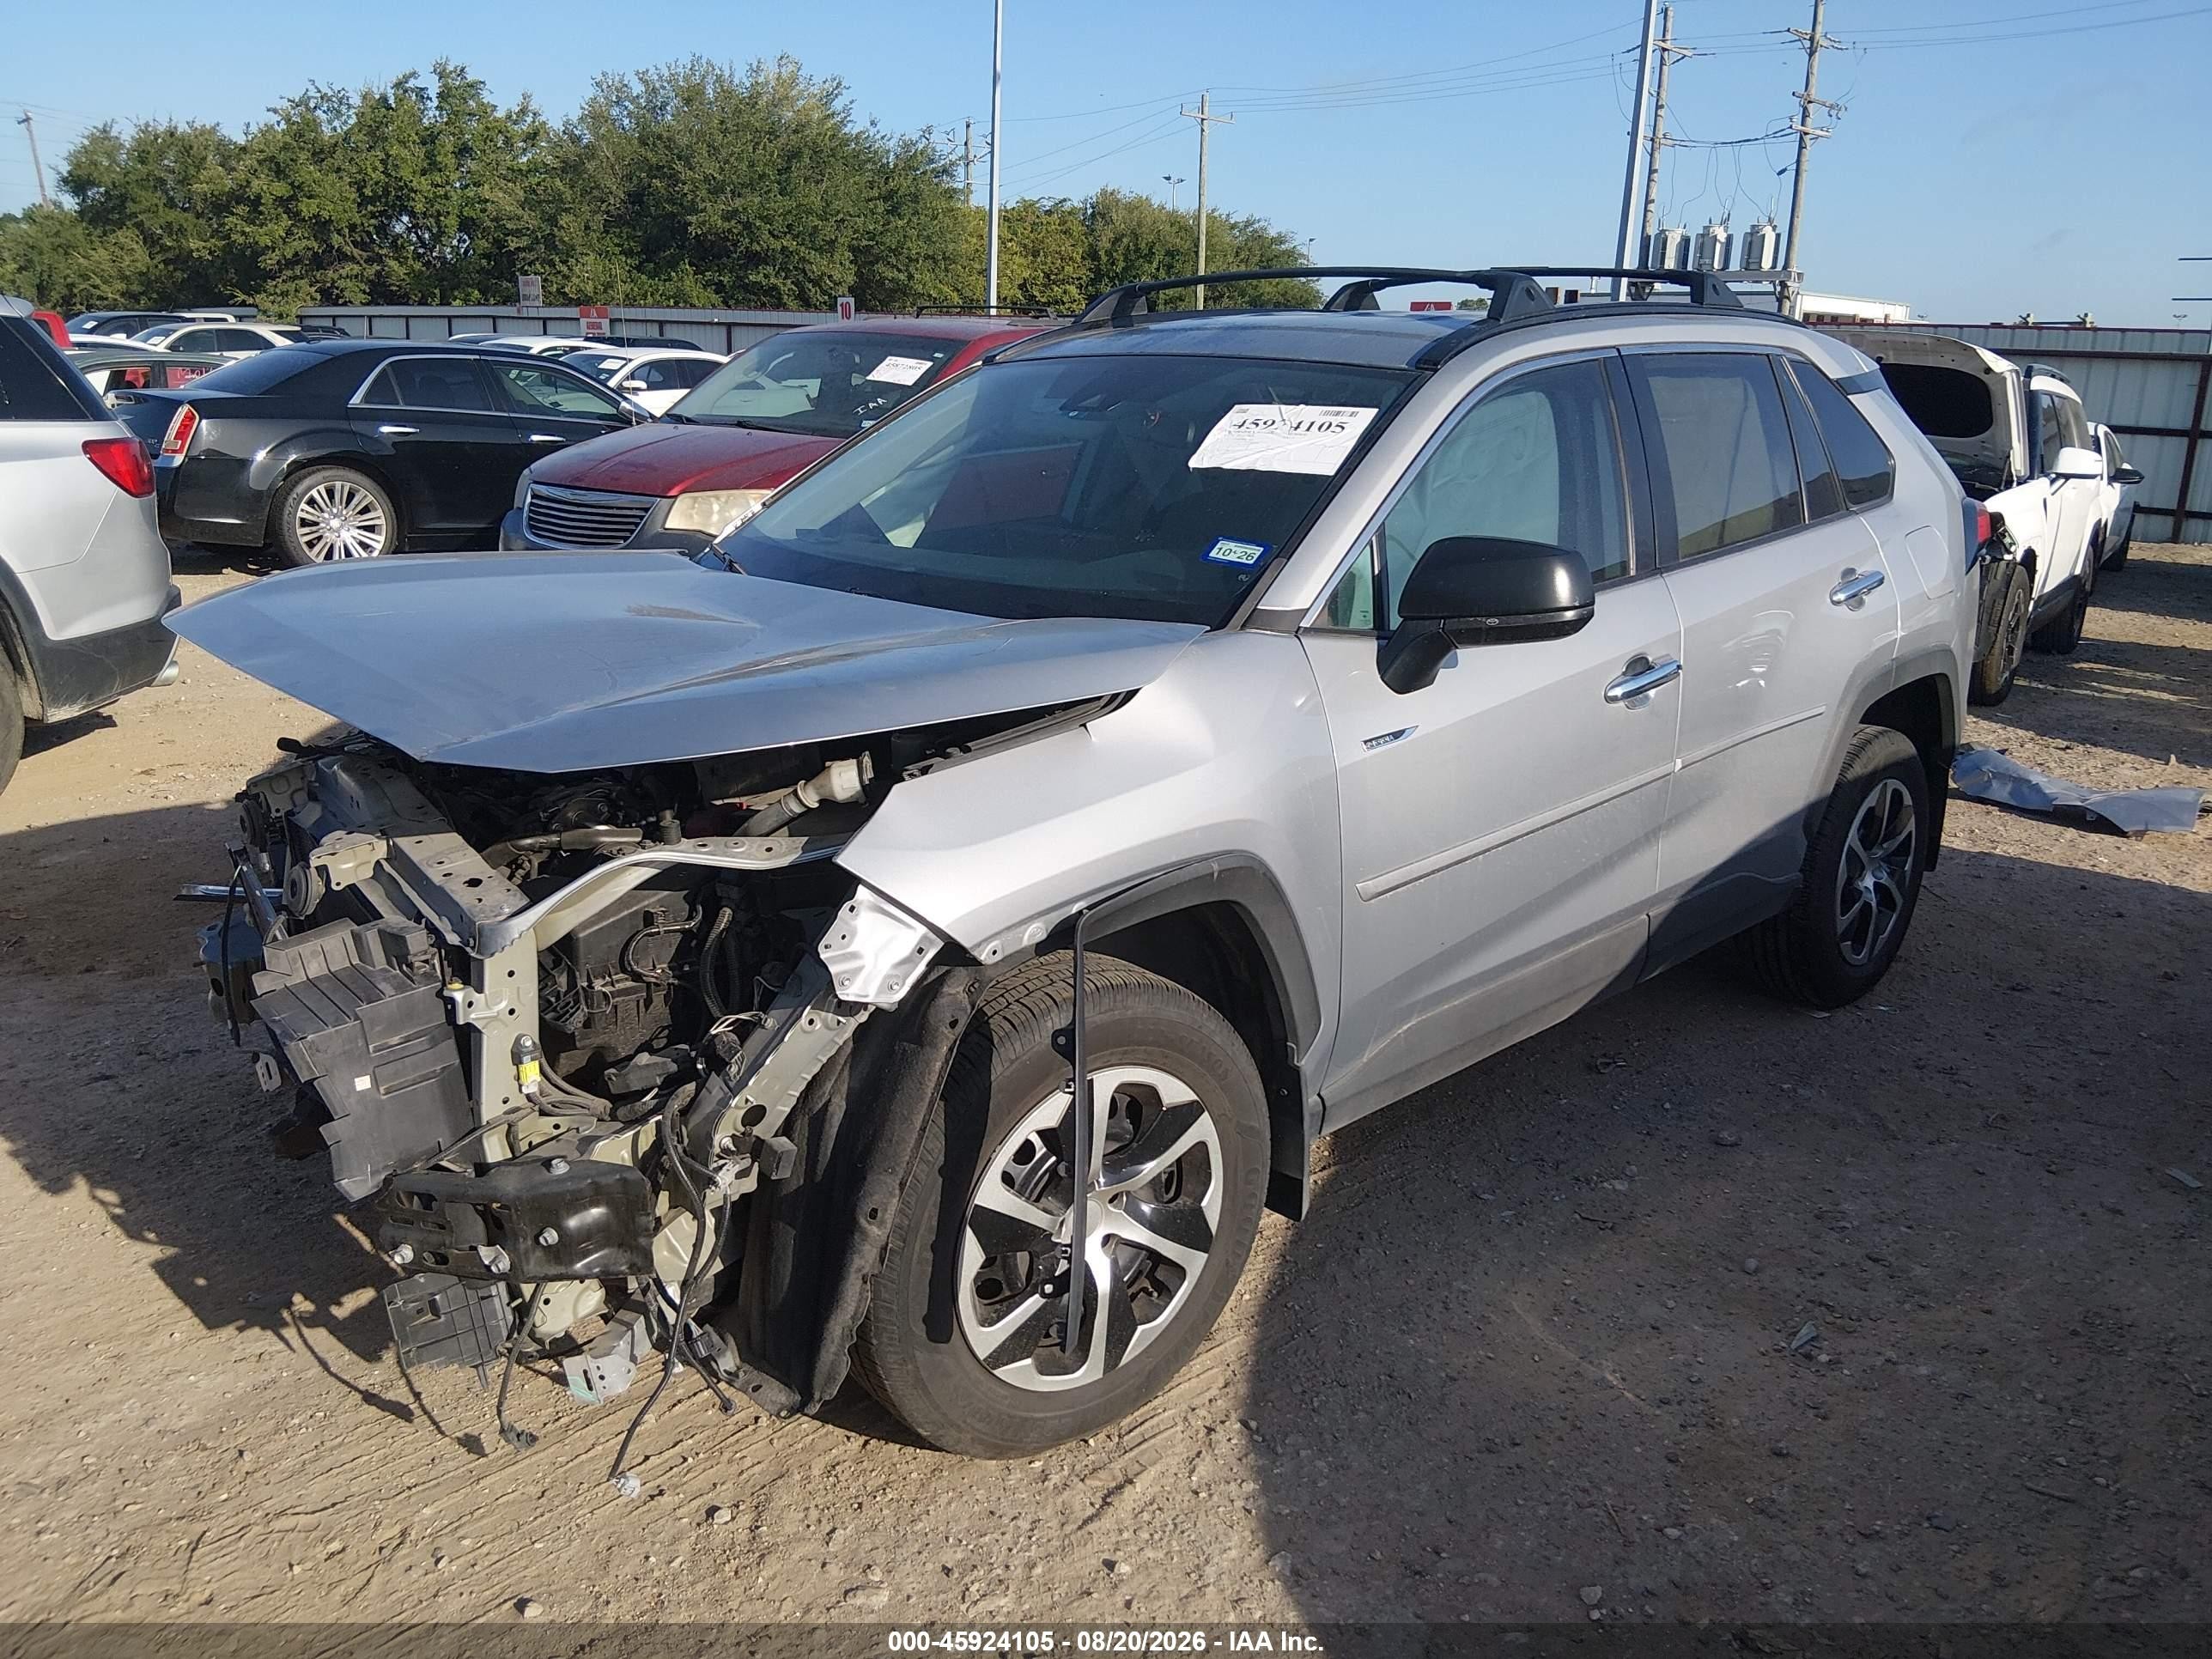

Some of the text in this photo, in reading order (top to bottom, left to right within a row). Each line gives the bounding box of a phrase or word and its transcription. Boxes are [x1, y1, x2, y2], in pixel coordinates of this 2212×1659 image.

[839, 301, 852, 320] 10
[852, 397, 888, 416] IAA
[1215, 546, 1233, 557] 10
[1237, 550, 1257, 562] 26
